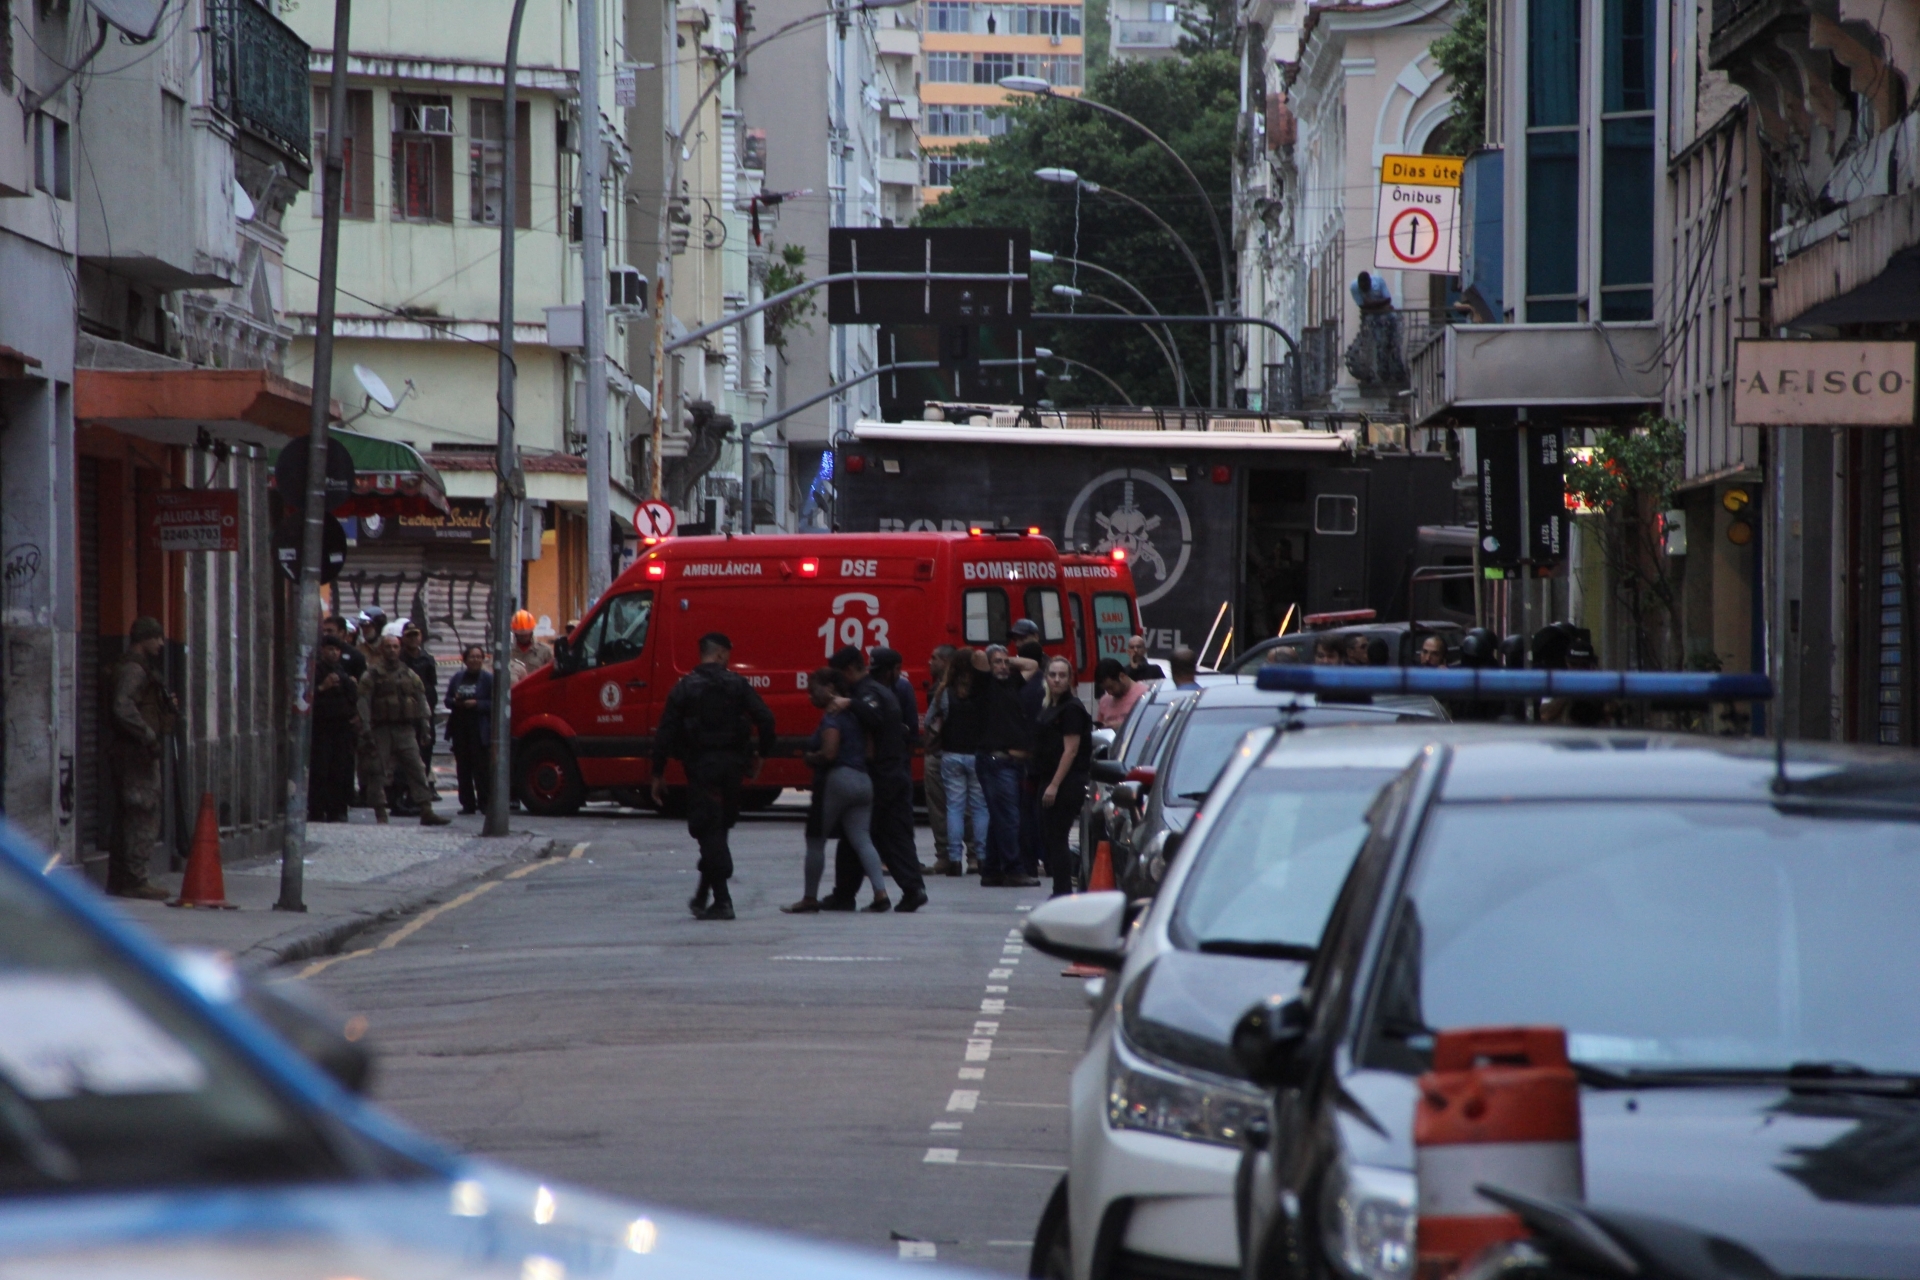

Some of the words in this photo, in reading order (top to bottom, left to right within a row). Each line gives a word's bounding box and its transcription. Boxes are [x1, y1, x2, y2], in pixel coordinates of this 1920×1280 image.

[1393, 163, 1426, 178] Dias
[1433, 165, 1462, 180] úte
[1392, 186, 1442, 204] Ônibus
[446, 507, 483, 528] Social
[682, 561, 763, 577] AMBULÂNCIA
[840, 559, 878, 577] DSE
[963, 562, 1057, 580] BOMBEIROS
[1064, 565, 1118, 578] MBEIROS
[818, 617, 889, 659] 193
[1104, 634, 1127, 653] 192
[1143, 628, 1189, 651] VEL
